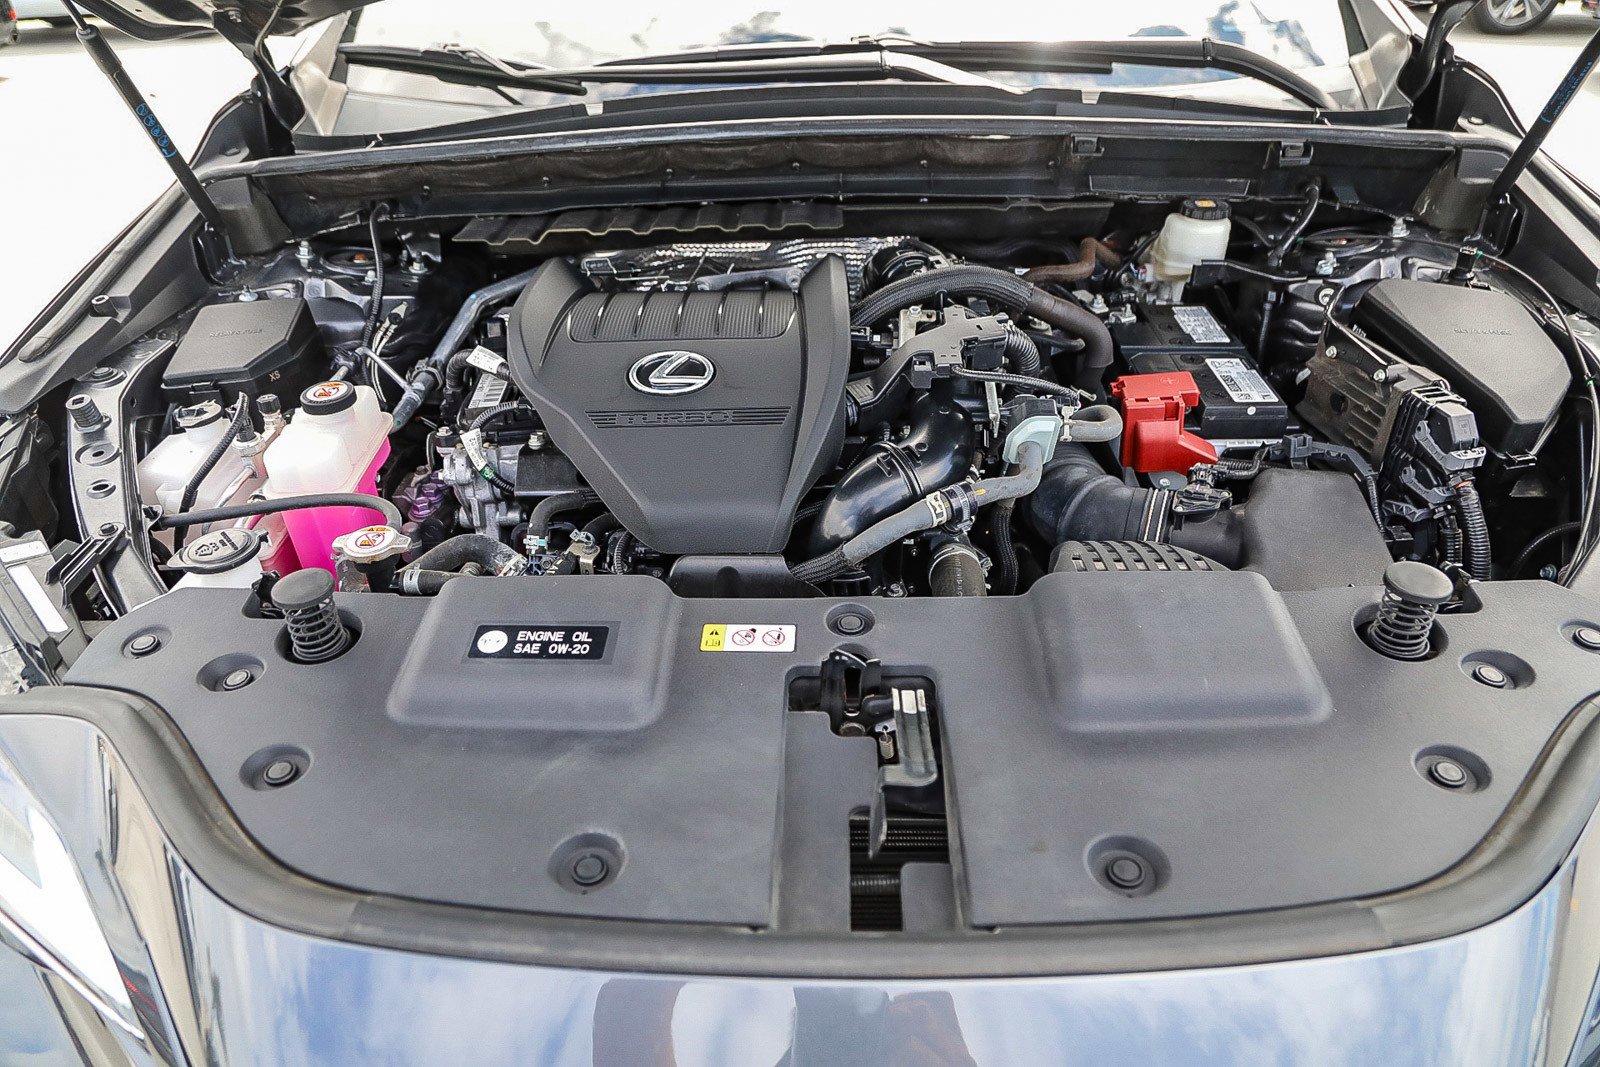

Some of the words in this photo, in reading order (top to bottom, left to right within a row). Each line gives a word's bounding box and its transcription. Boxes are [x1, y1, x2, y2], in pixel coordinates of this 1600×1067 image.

[619, 410, 731, 425] TURBO
[516, 630, 566, 642] ENGINE
[571, 631, 593, 642] OIL
[513, 643, 542, 654] SAE
[548, 643, 590, 654] 0W-20
